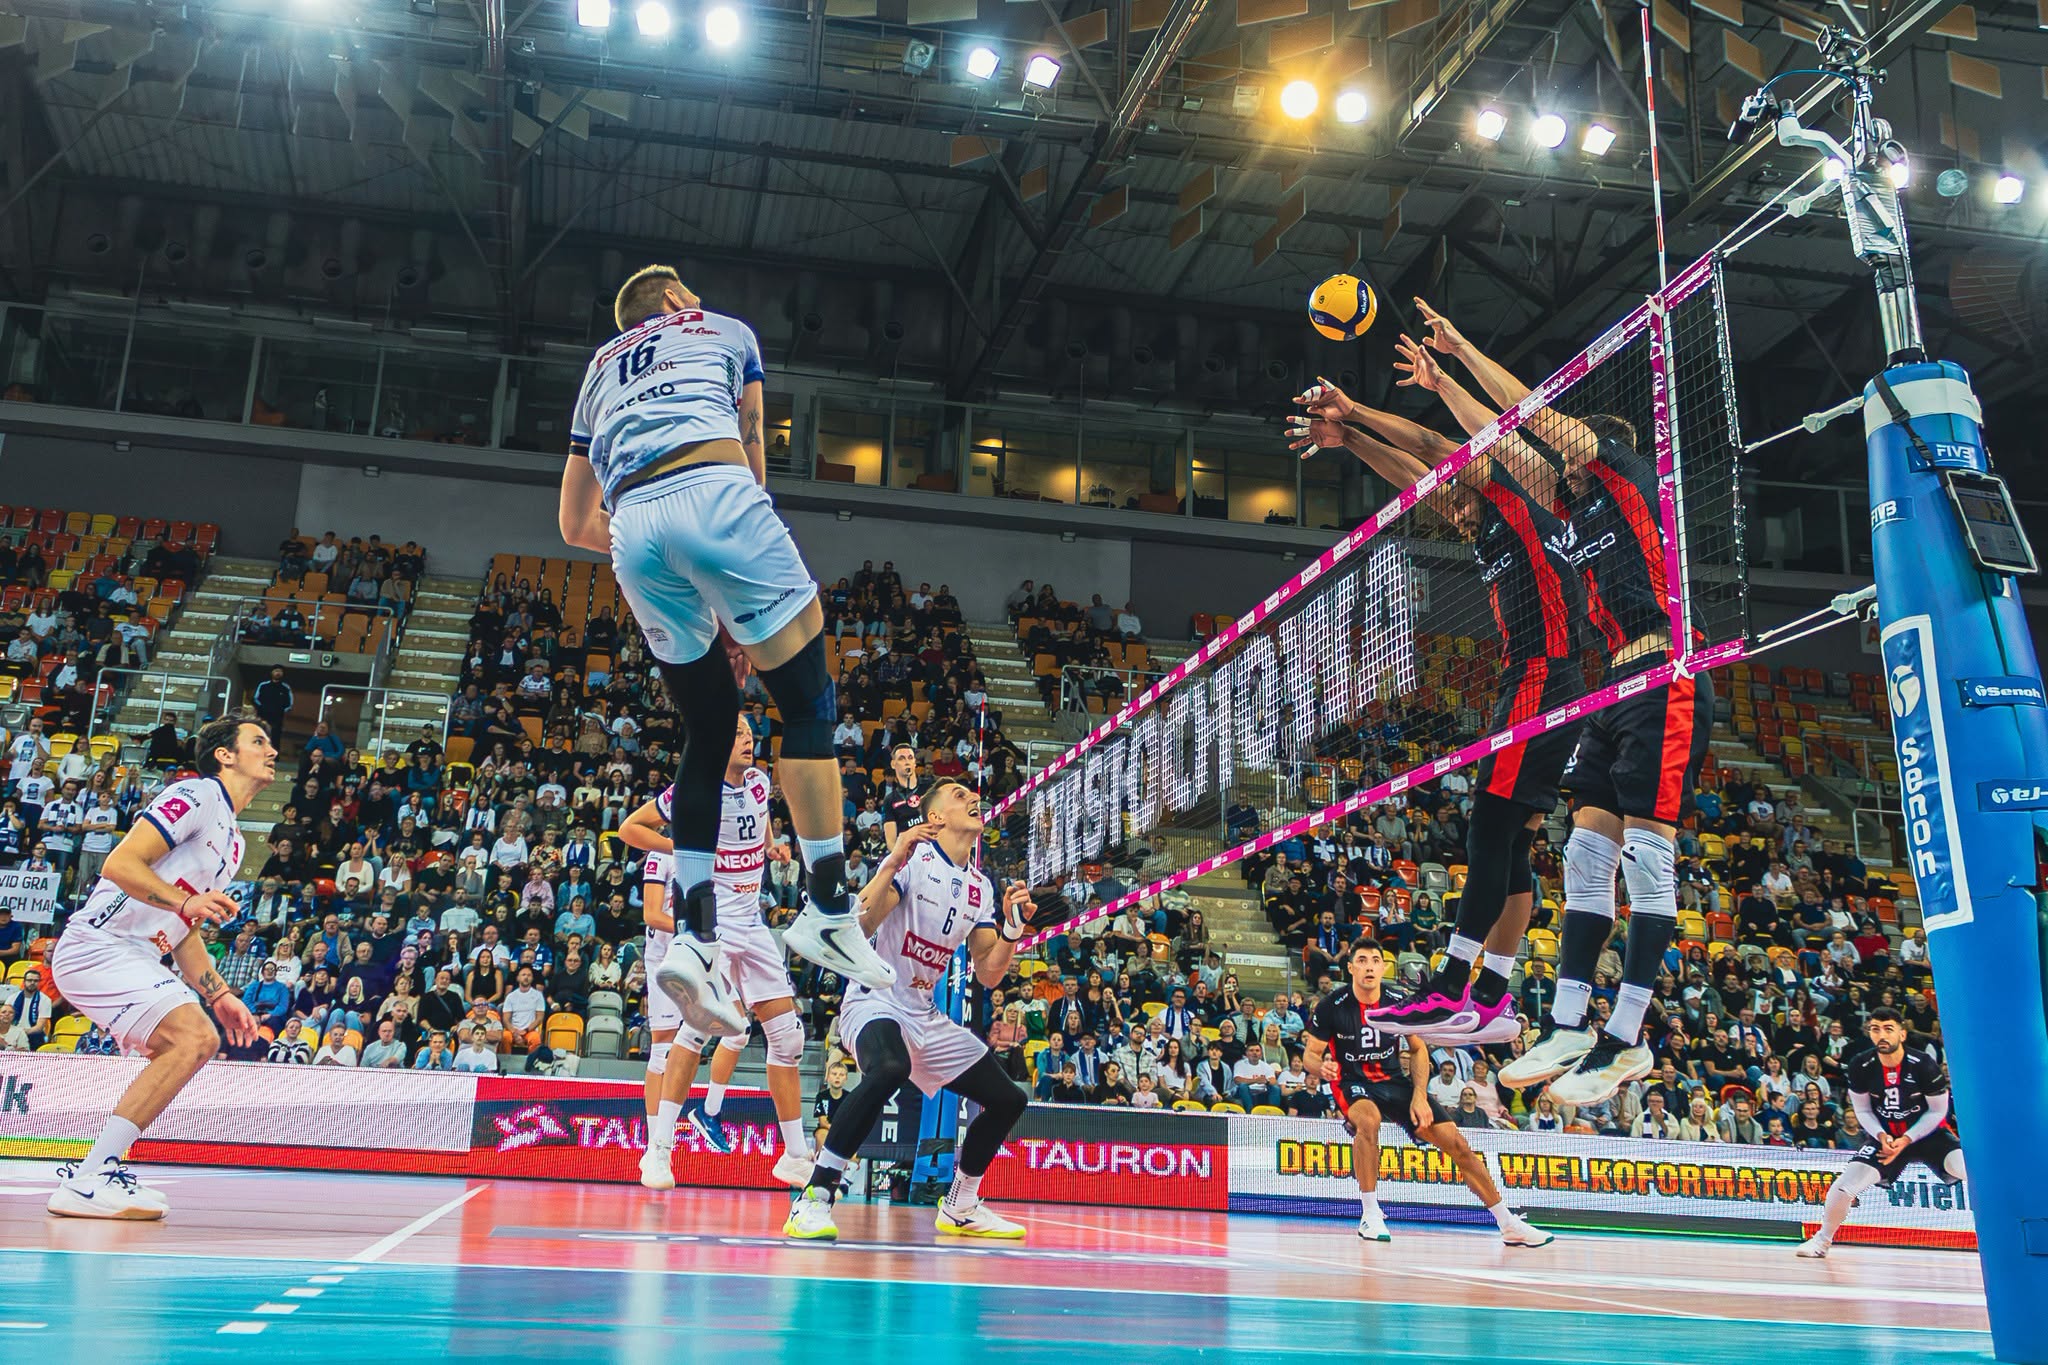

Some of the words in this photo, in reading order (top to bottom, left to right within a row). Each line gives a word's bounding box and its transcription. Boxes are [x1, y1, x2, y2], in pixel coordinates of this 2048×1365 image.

[617, 334, 662, 386] 16
[1936, 444, 1976, 461] FIVB
[1871, 500, 1897, 527] FIVB
[1986, 686, 2042, 699] Senoh
[737, 815, 756, 840] 22
[22, 876, 48, 891] GRA
[942, 907, 957, 936] 6
[1361, 1027, 1380, 1048] 21
[1884, 1087, 1900, 1105] 19
[1020, 1138, 1212, 1178] TAURON
[1859, 1144, 1876, 1157] 19
[1278, 1139, 1487, 1184] DRUARN
[1498, 1152, 1859, 1207] WIELKOFORMATOW
